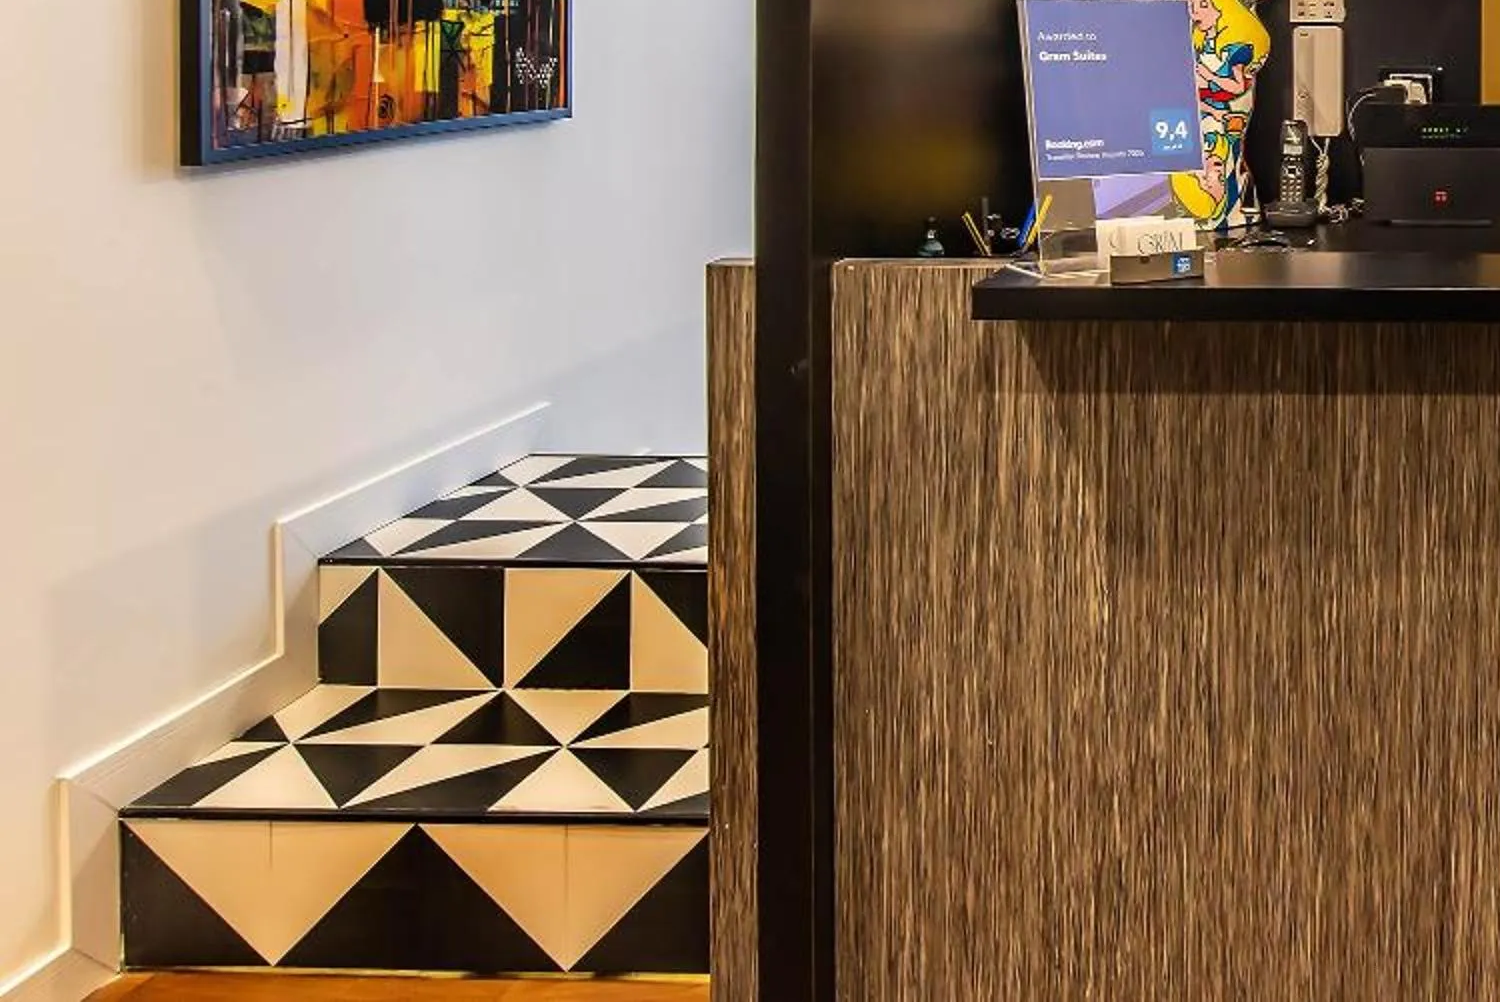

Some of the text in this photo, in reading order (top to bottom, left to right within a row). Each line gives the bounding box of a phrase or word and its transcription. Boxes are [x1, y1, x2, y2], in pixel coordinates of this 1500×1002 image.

[1039, 50, 1107, 61] Gram Suites
[1155, 121, 1188, 141] 9,4
[1045, 139, 1105, 151] Booking.com
